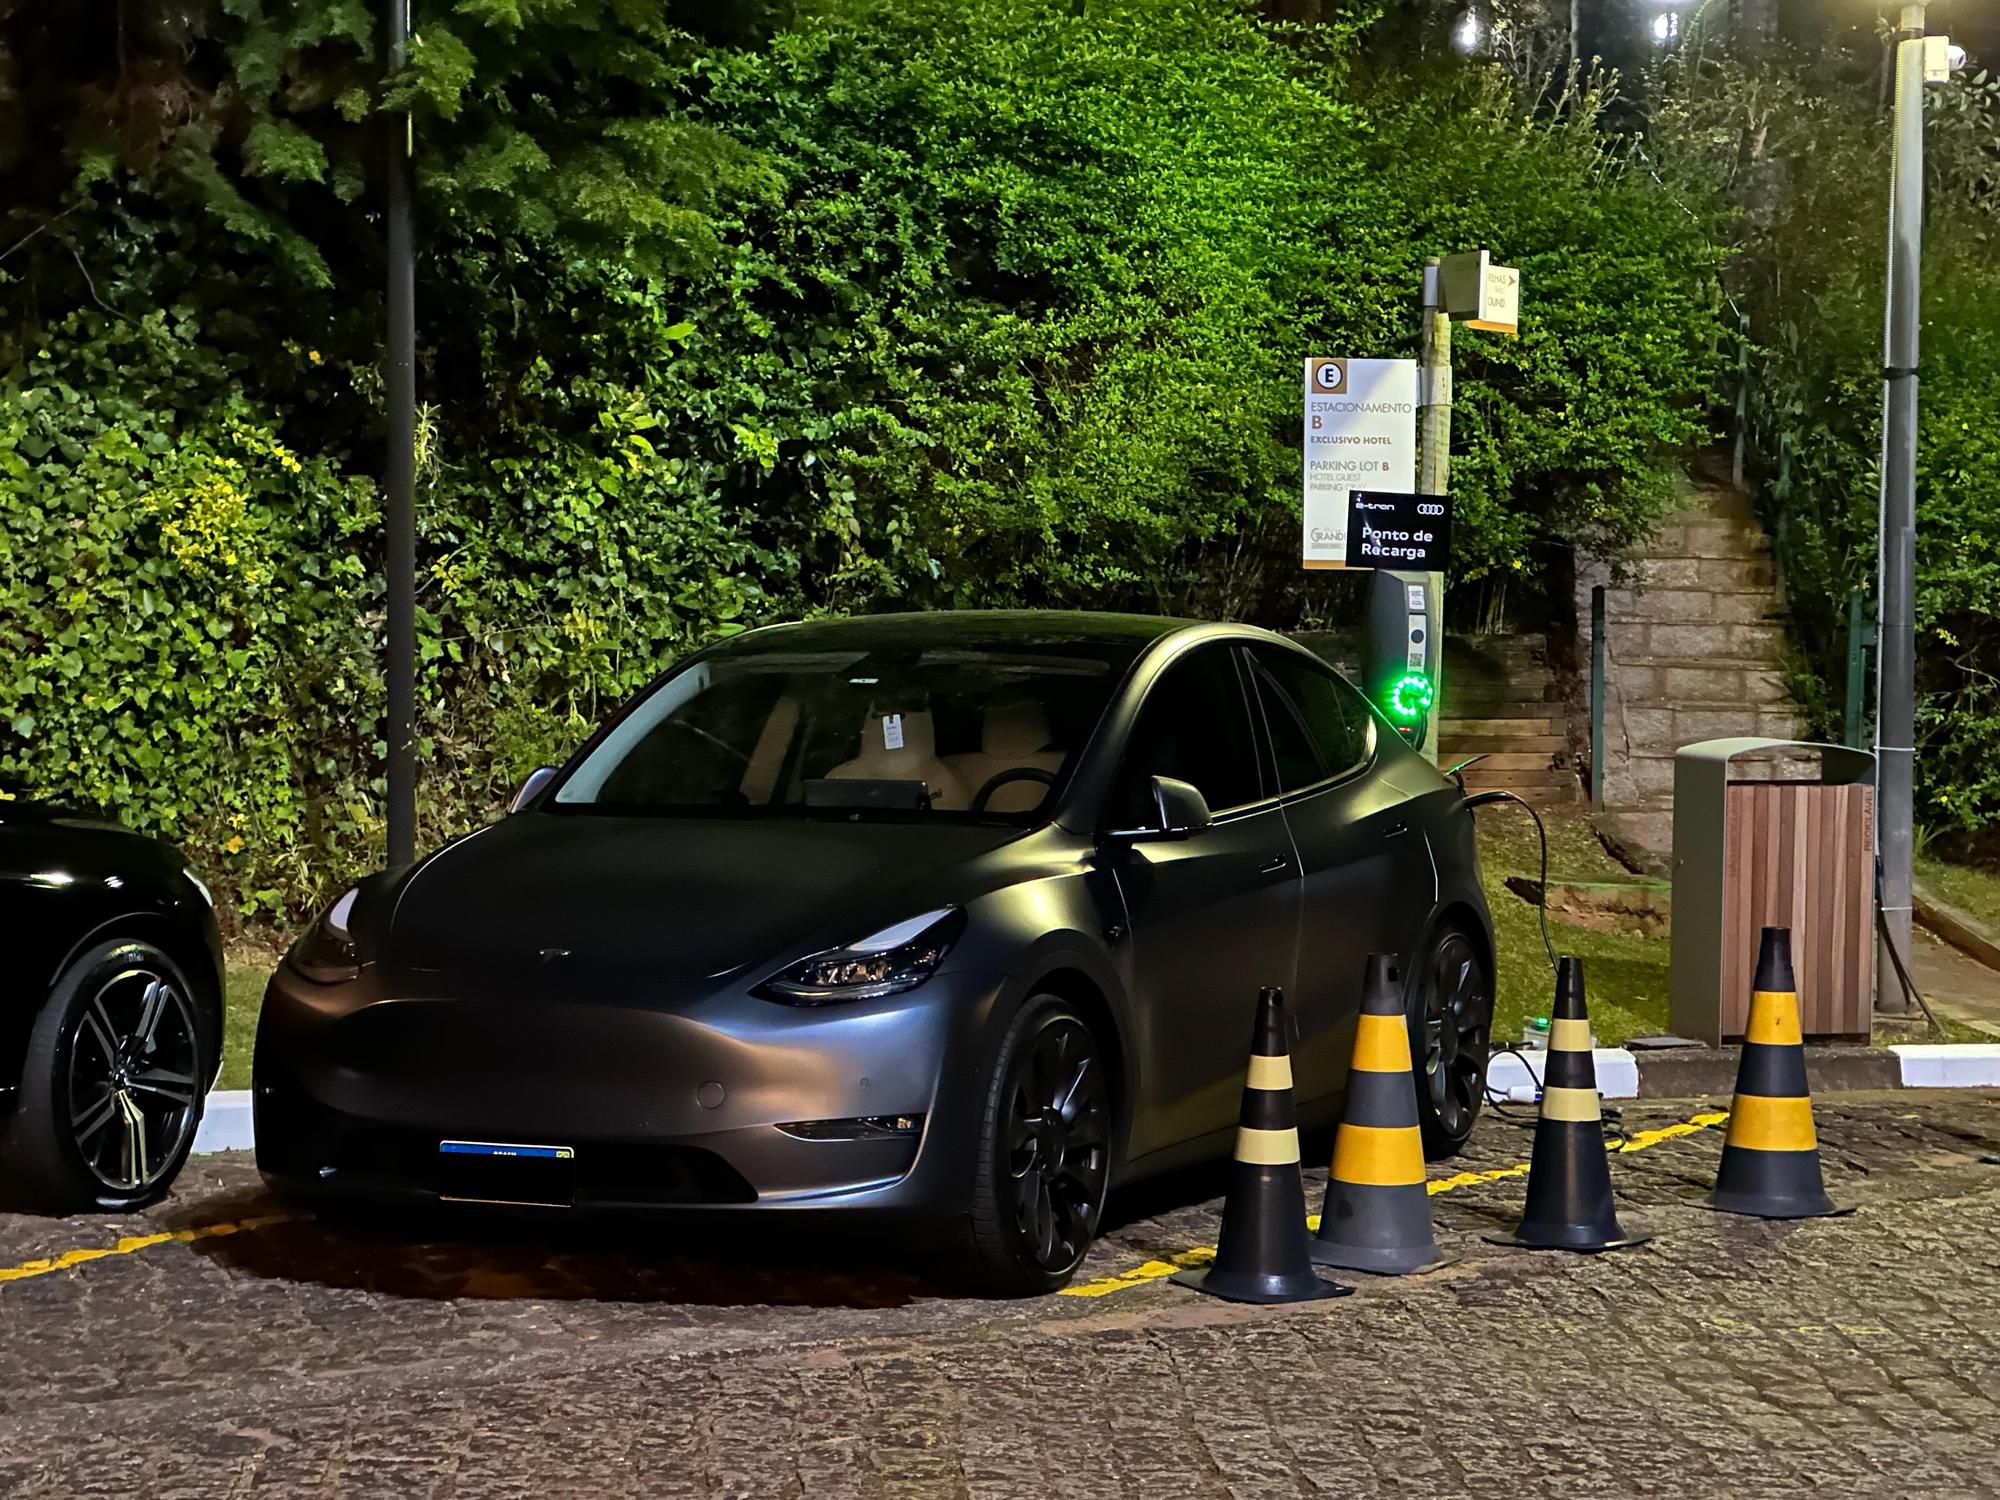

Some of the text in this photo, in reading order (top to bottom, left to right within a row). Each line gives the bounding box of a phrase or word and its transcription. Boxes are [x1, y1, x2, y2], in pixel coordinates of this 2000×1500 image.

[1325, 368, 1334, 383] E
[1311, 402, 1412, 413] ESTACIONAMENTO
[1312, 415, 1323, 429] B
[1310, 436, 1392, 445] EXCLUSIVO HOTEL
[1310, 461, 1390, 471] PARKING LOT B
[1309, 473, 1361, 482] HOTEL GUEST
[1310, 483, 1343, 491] PARKING
[1311, 528, 1346, 542] GRAND
[1362, 526, 1434, 542] Ponto de
[1361, 543, 1426, 560] Recarga
